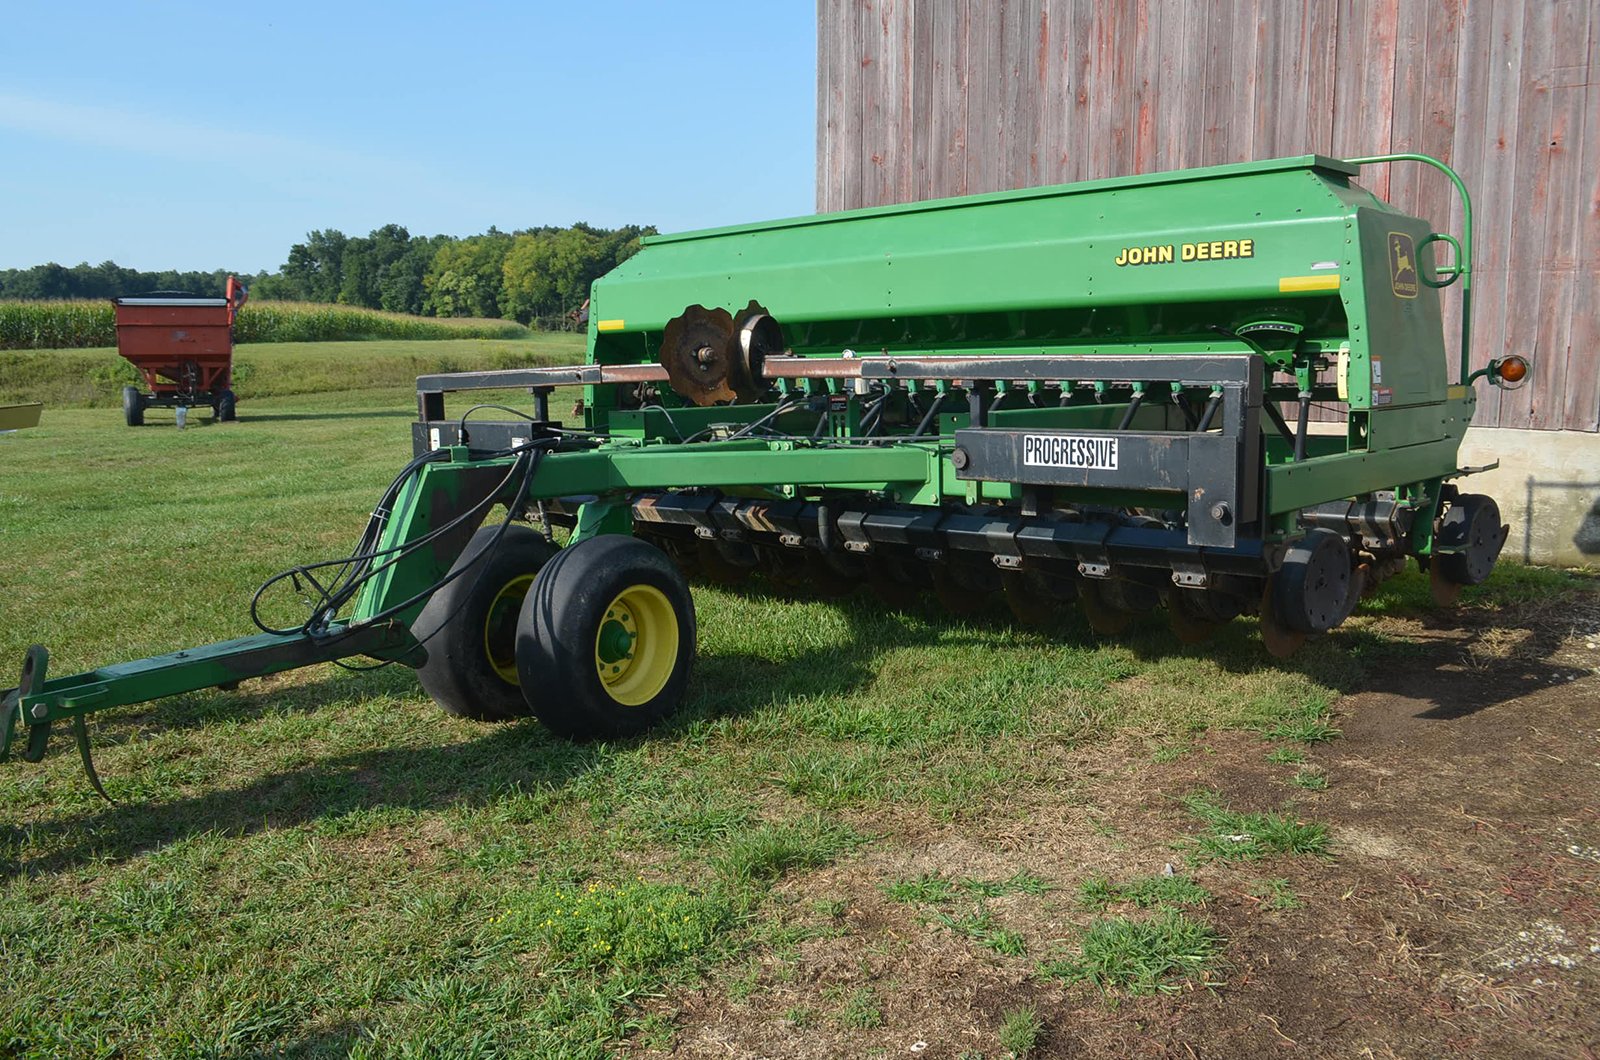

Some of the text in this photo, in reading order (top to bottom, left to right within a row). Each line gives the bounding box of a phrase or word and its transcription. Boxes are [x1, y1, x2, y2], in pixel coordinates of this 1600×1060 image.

[1115, 239, 1254, 266] JOHN DEERE
[1025, 437, 1116, 468] PROGRESSIVE
